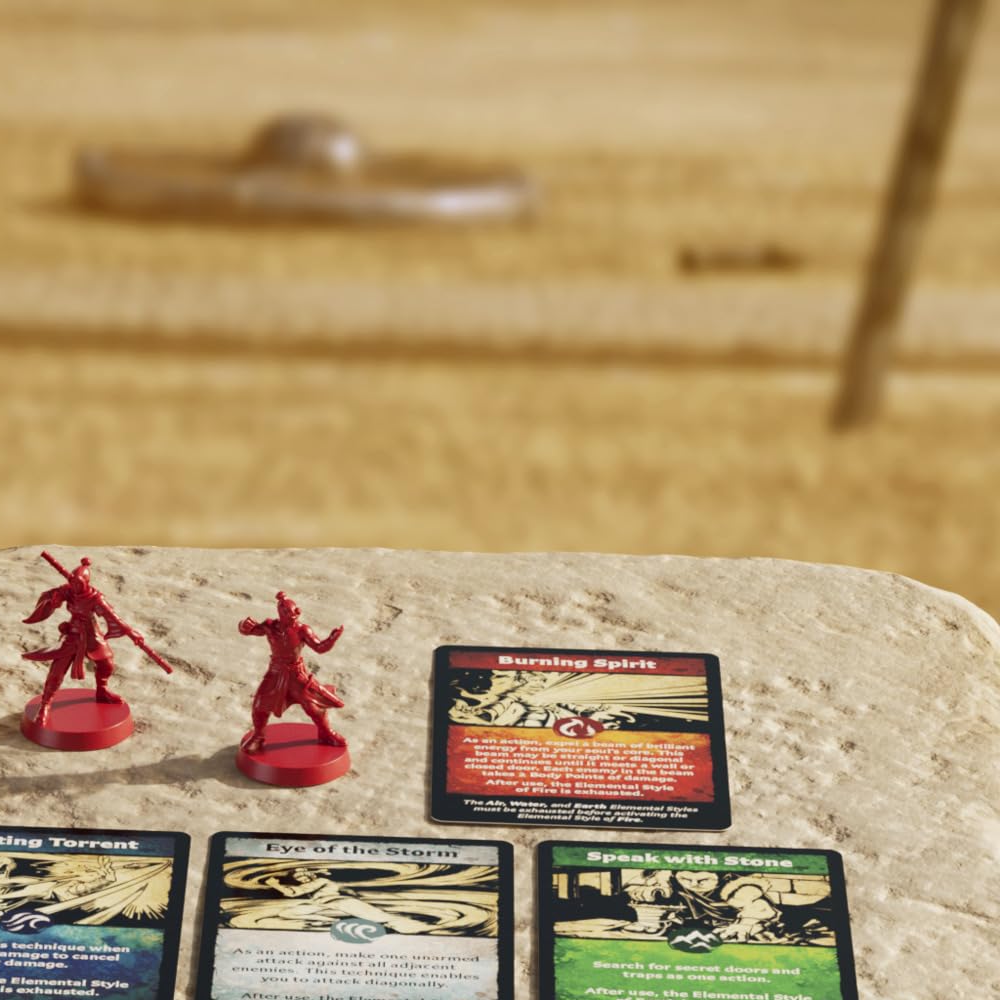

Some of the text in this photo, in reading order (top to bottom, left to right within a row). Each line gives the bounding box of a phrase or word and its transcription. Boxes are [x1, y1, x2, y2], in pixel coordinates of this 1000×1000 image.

[498, 655, 657, 670] Burning Spirit
[486, 779, 519, 787] After
[550, 780, 572, 788] the
[574, 782, 639, 790] Elemental
[642, 784, 674, 792] Style
[574, 788, 645, 797] exhausted.
[49, 837, 140, 850] Torrent
[266, 843, 459, 858] Eye of the Storm
[587, 851, 793, 867] Speak with Stone
[11, 942, 86, 952] technique
[89, 944, 130, 953] when
[72, 953, 120, 961] cancel
[4, 959, 68, 969] damage.
[593, 961, 644, 969] Search
[648, 962, 671, 970] for
[724, 965, 769, 974] doors
[772, 967, 800, 975] and
[11, 977, 87, 987] Elemental
[90, 979, 129, 989] Style
[622, 971, 663, 980] traps
[719, 974, 771, 983] action.
[0, 985, 13, 993] is
[16, 987, 100, 996] exhausted.
[585, 987, 625, 996] After
[628, 989, 659, 998] use,
[663, 989, 688, 998] the
[692, 990, 769, 1000] Elemental
